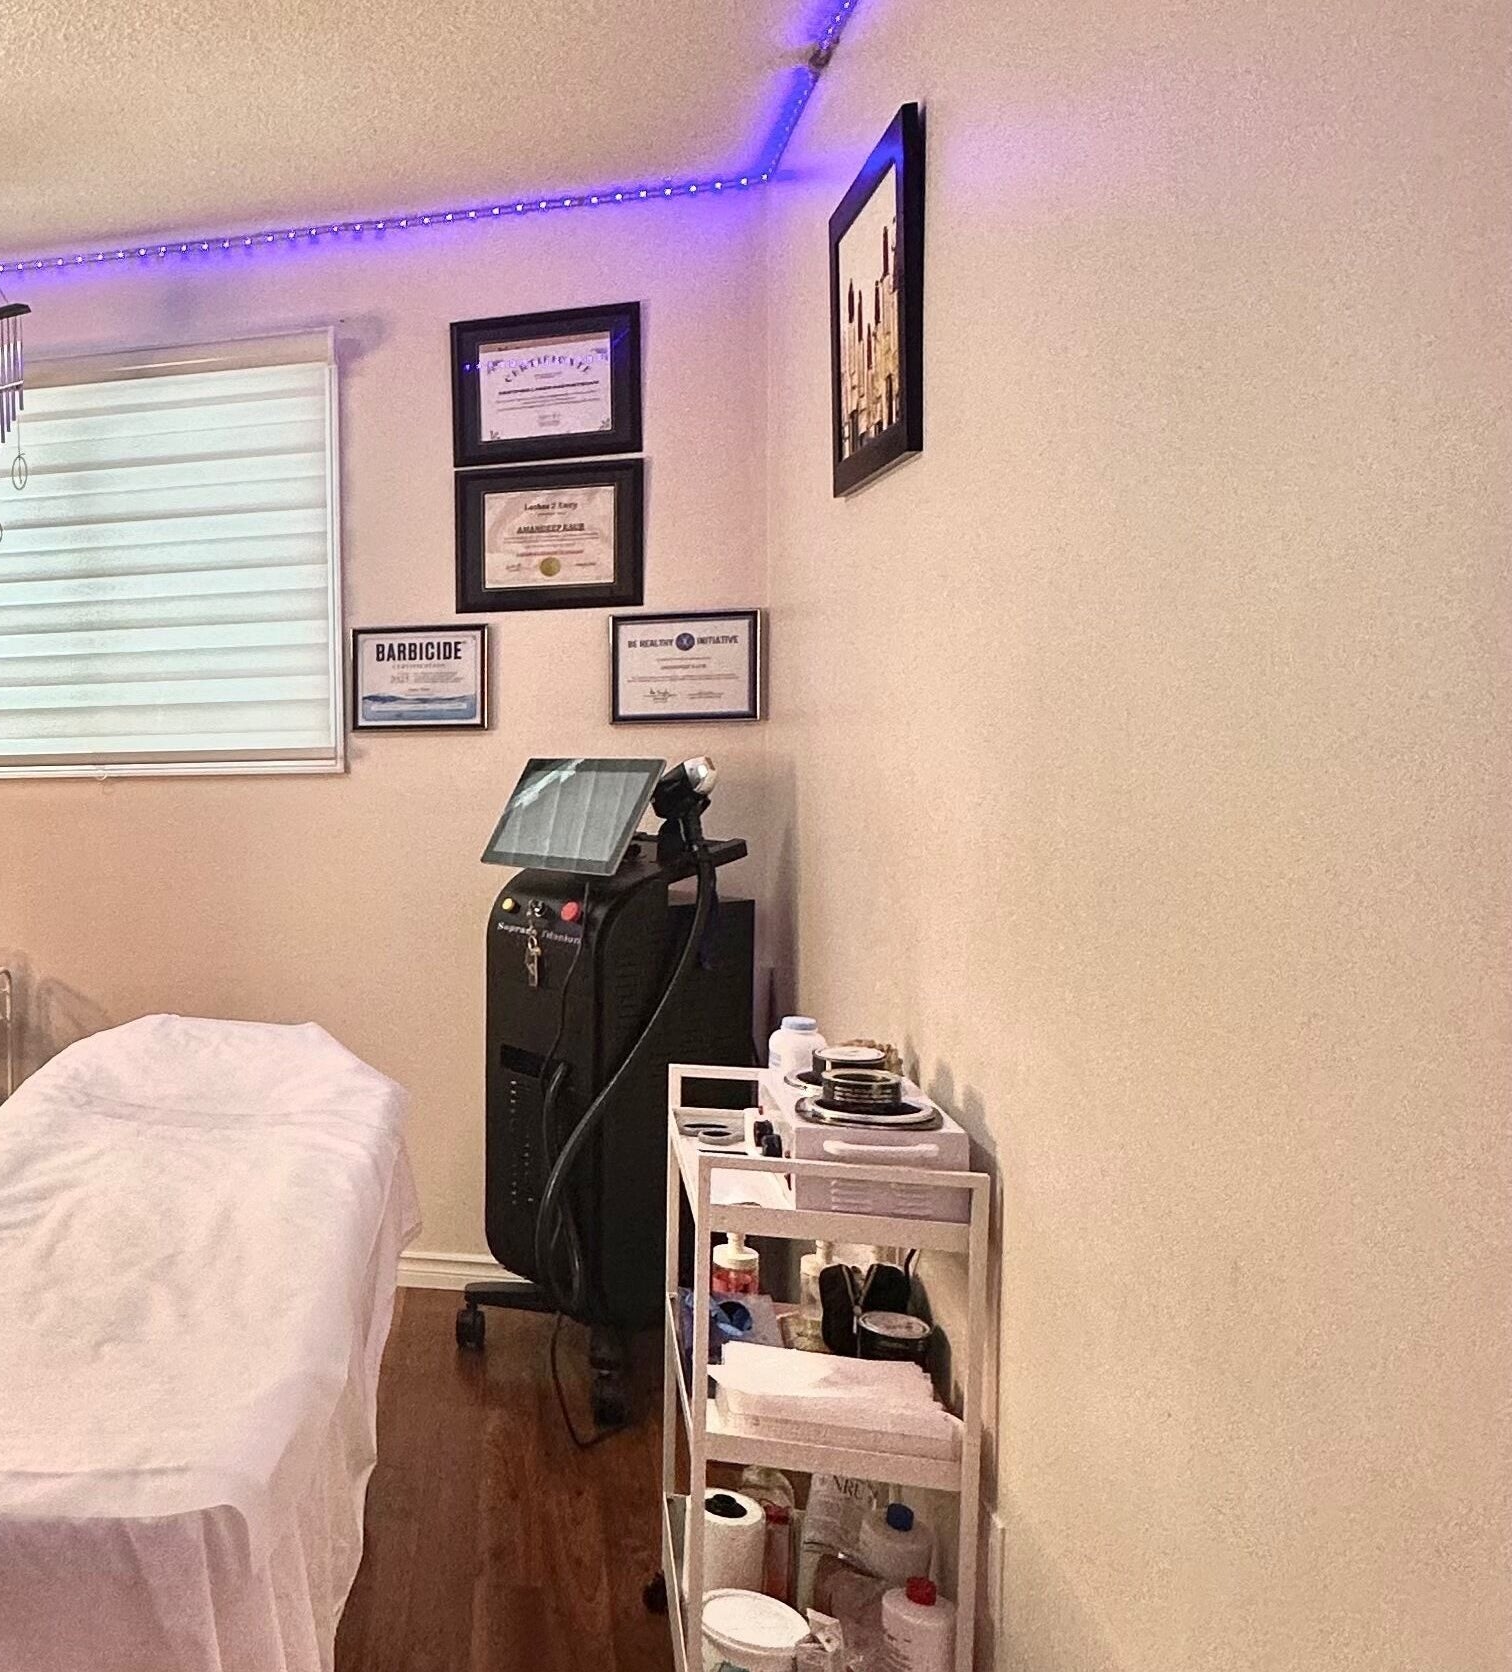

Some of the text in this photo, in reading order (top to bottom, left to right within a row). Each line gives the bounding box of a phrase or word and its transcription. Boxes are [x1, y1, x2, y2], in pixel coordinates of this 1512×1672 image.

[628, 635, 739, 649] BE HEALTHY INITIATIVE
[375, 641, 463, 662] BARBICIDE
